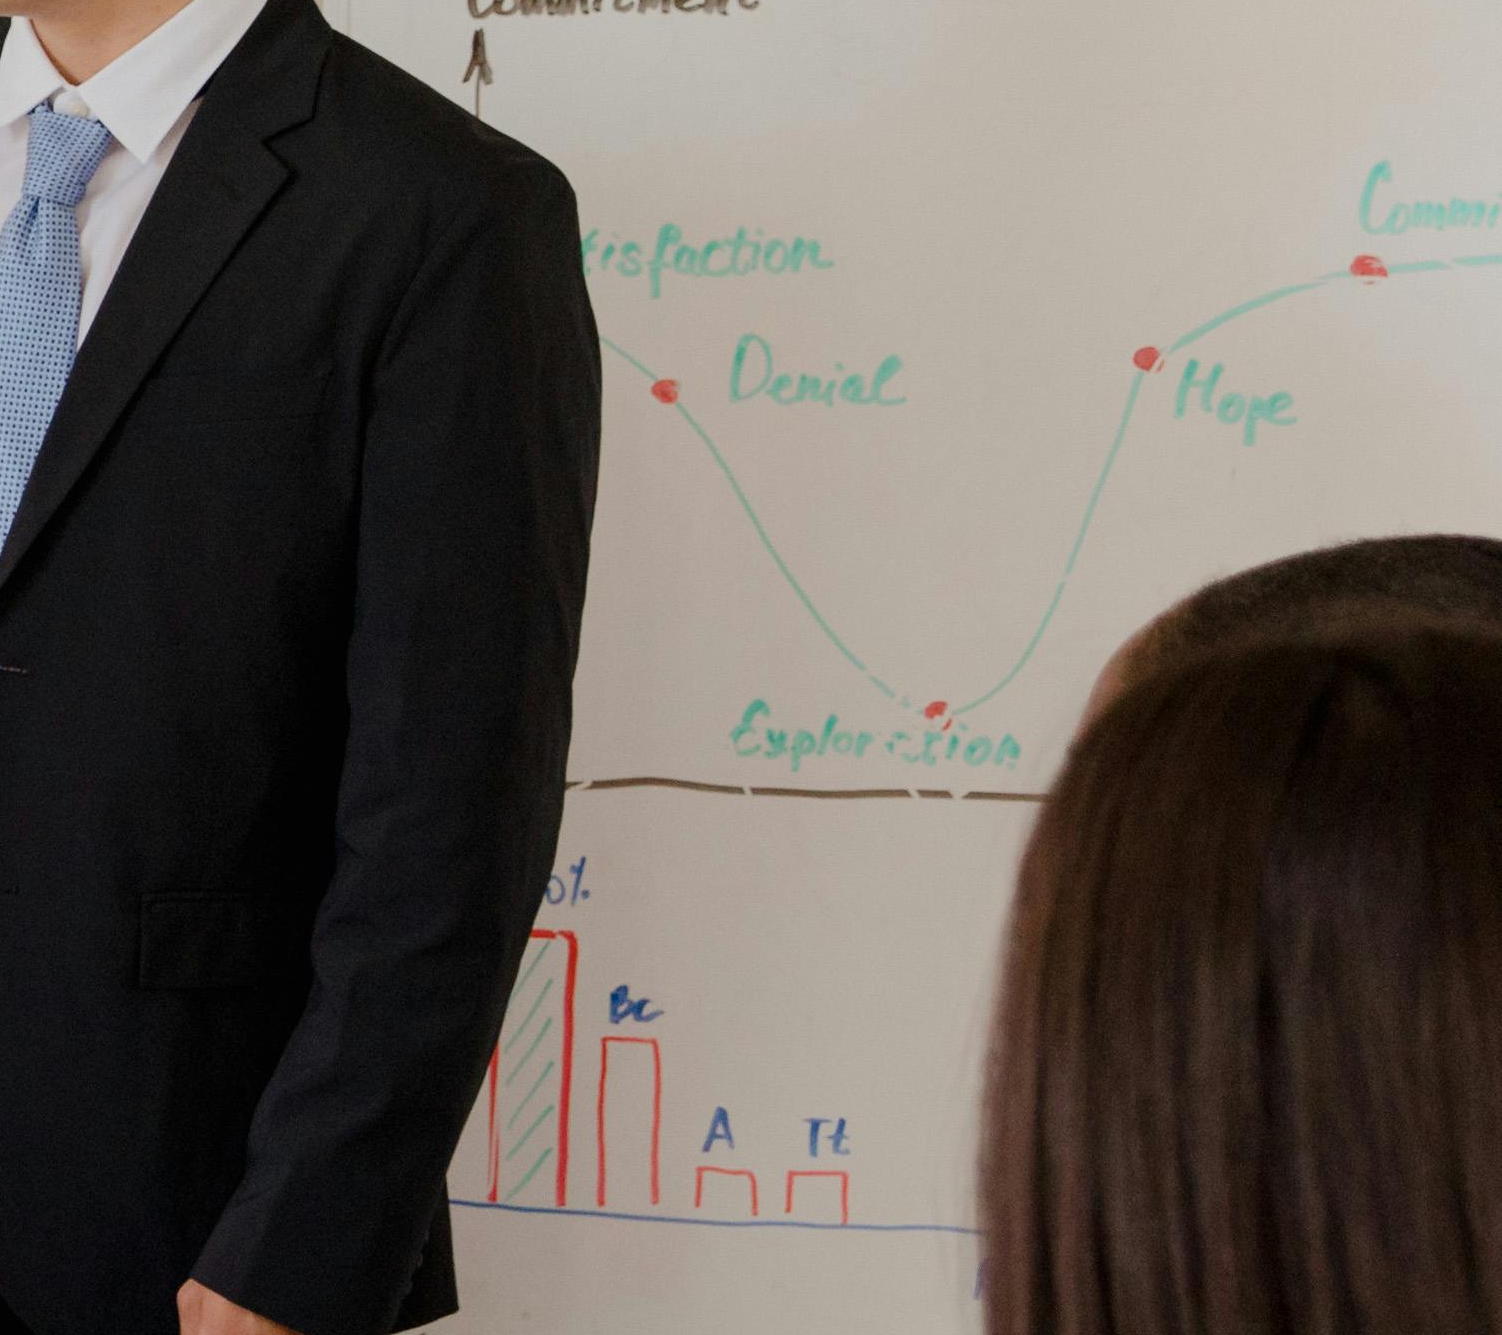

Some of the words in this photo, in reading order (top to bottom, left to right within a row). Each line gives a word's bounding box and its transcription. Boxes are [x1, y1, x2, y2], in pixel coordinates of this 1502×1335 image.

[730, 333, 907, 408] Denial
[1174, 358, 1298, 447] Hope
[702, 1106, 734, 1152] A
